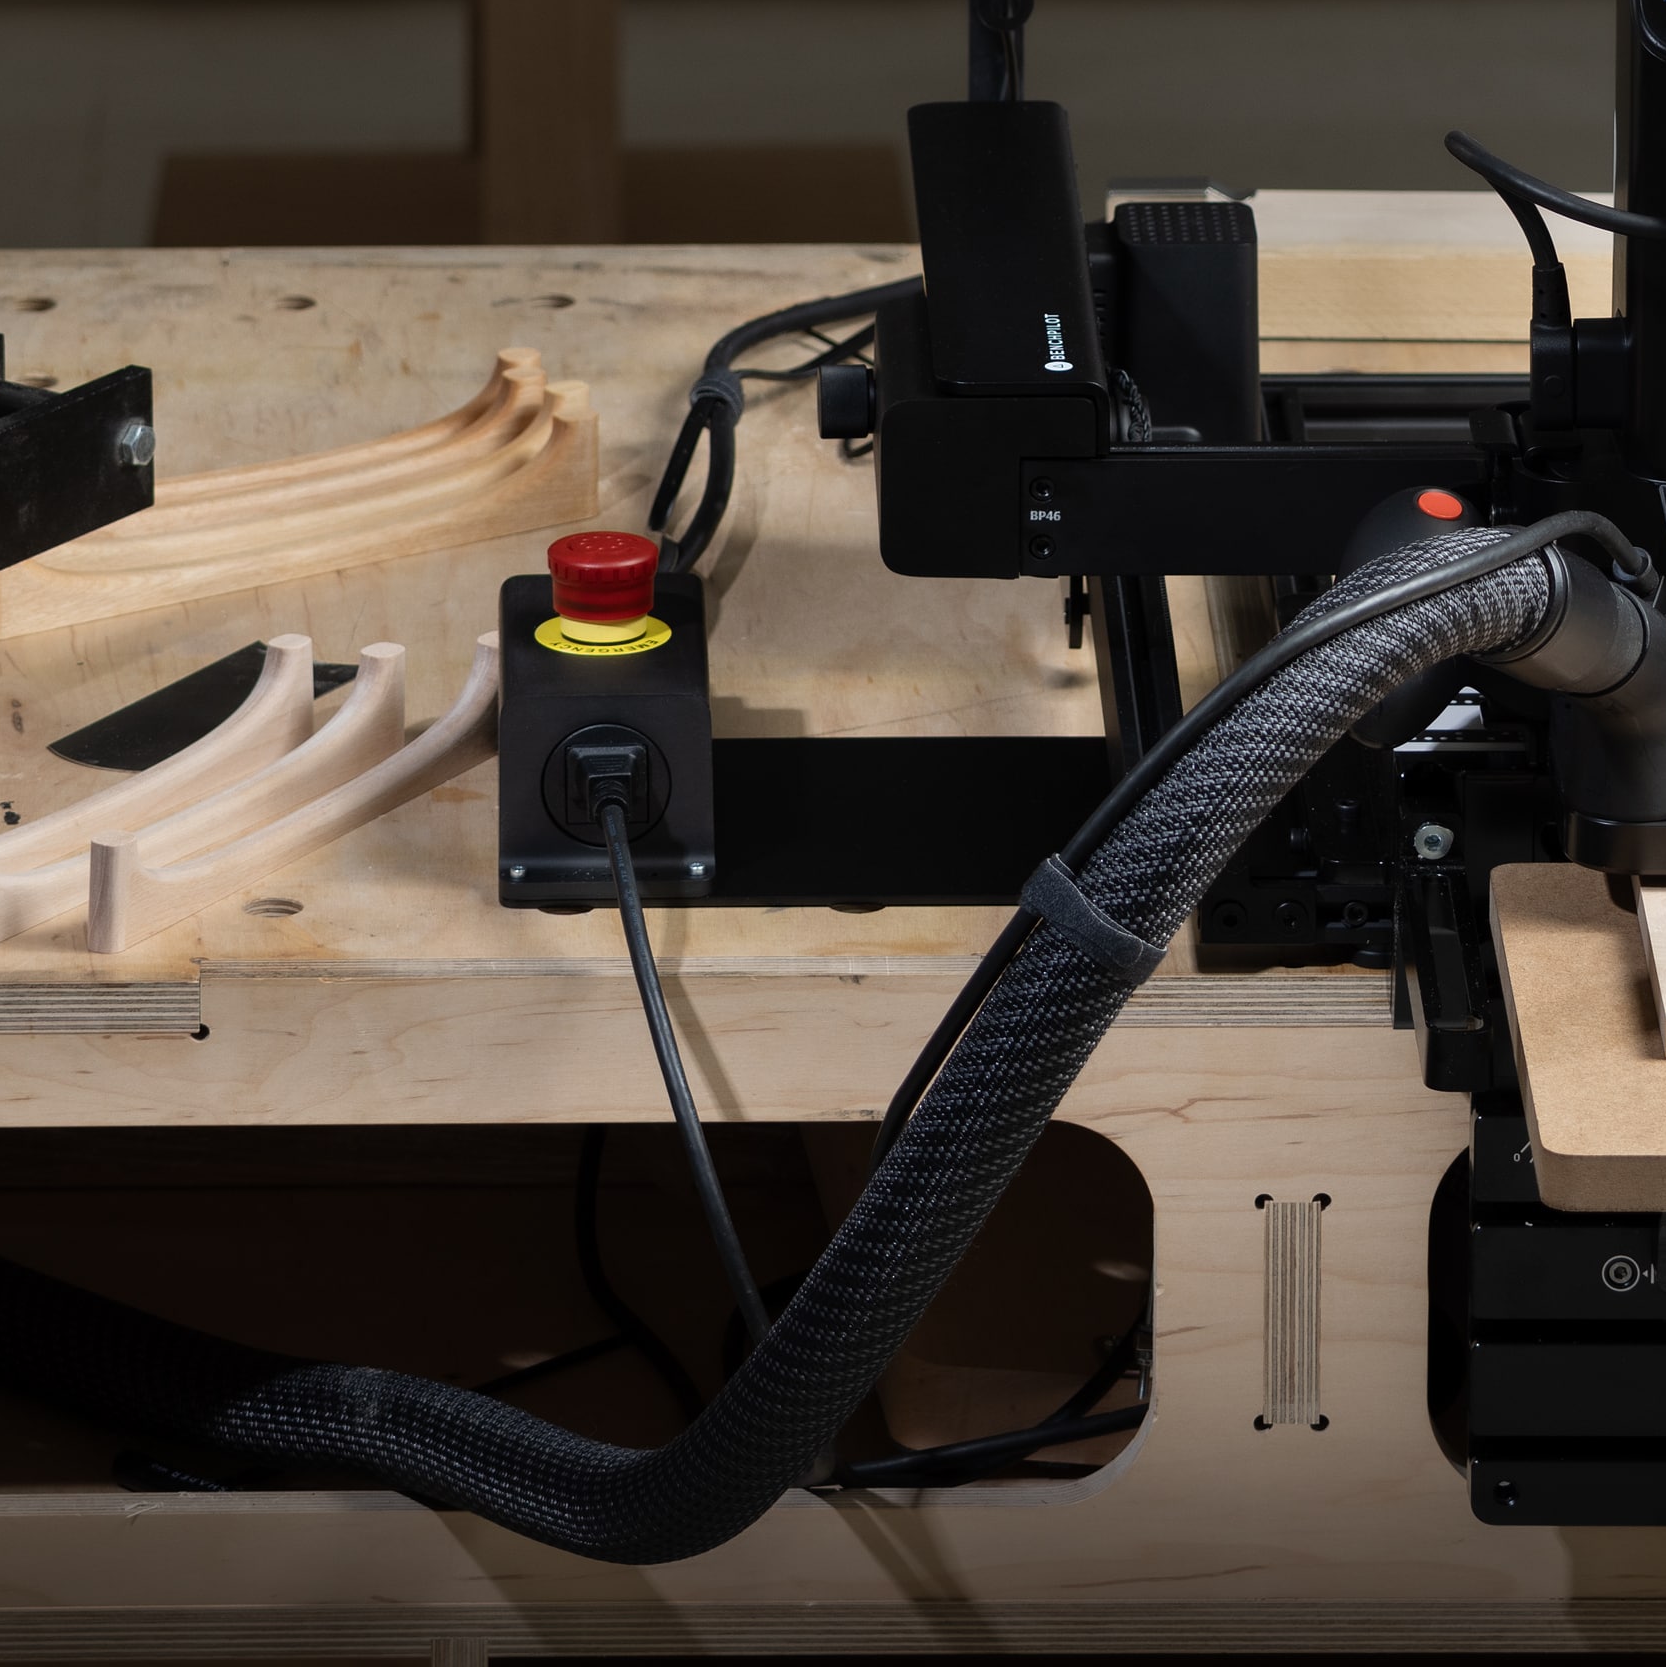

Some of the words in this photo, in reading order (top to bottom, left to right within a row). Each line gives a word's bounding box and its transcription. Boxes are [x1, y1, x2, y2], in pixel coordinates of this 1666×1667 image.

[1044, 313, 1066, 360] BENCHPILOT
[1029, 510, 1062, 522] BP46
[550, 639, 659, 653] EMERGENCY
